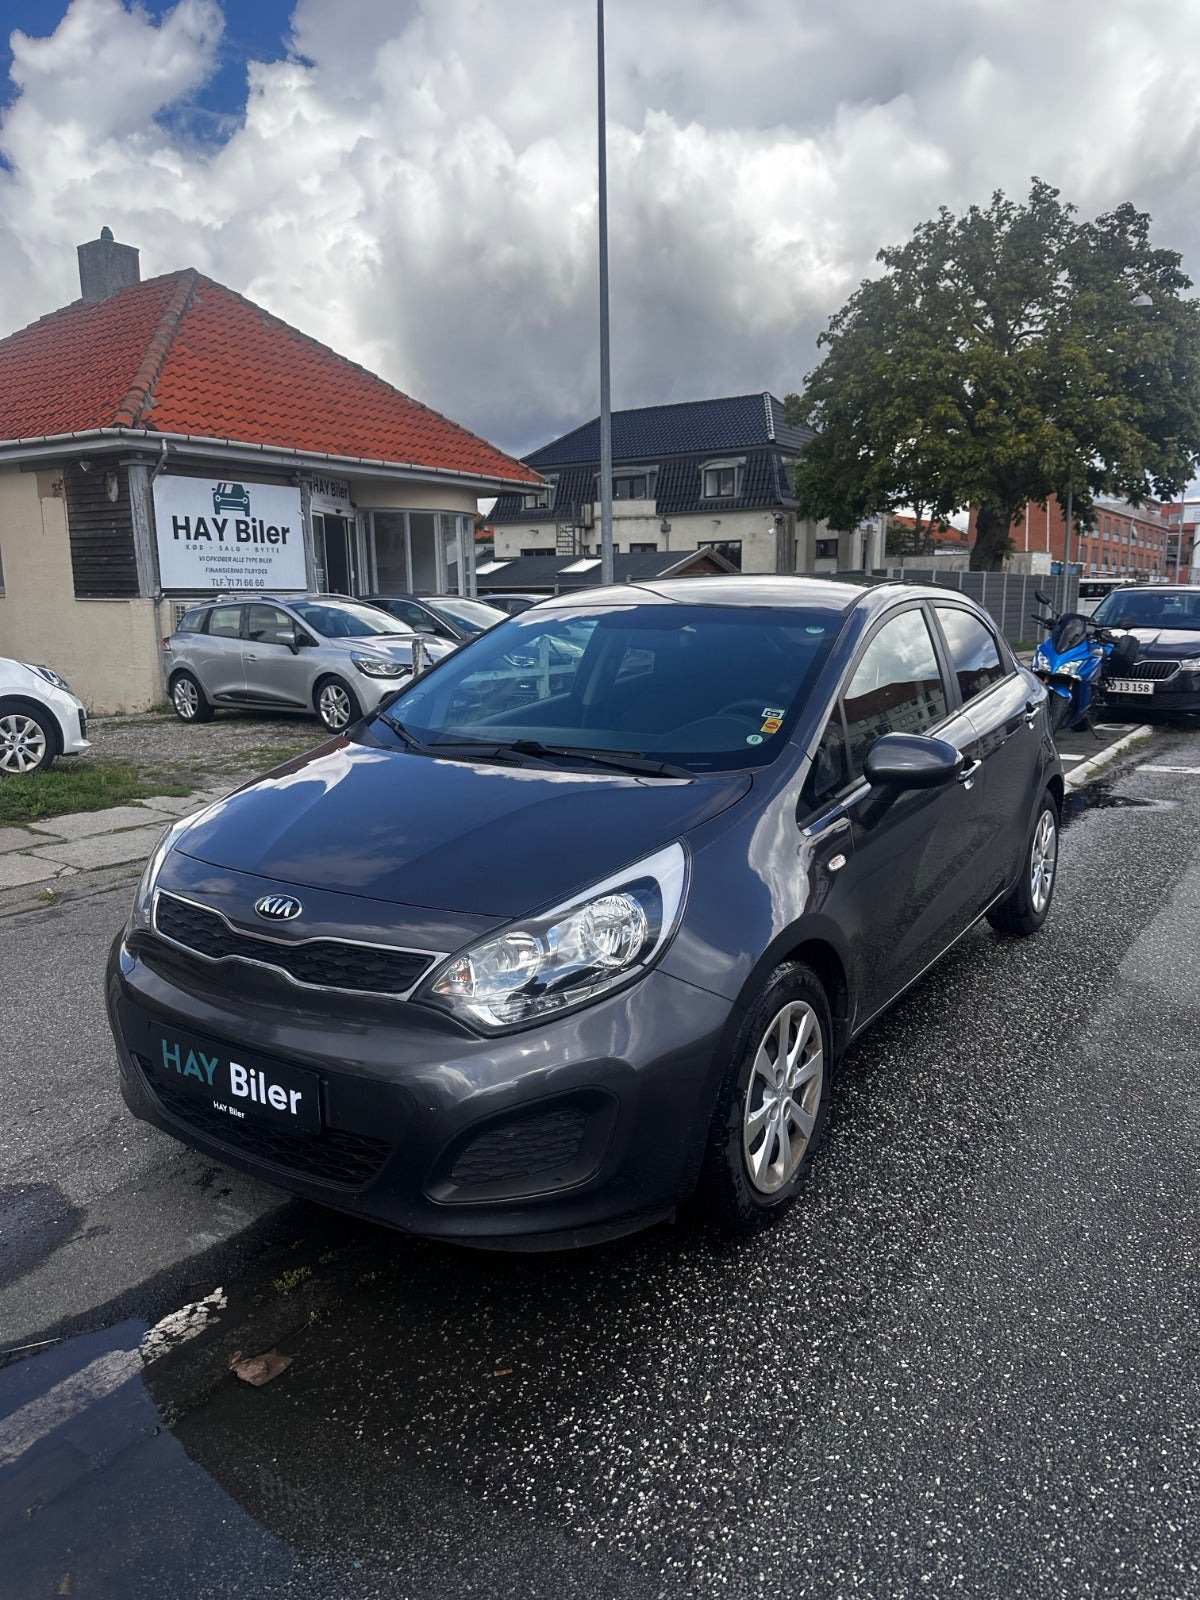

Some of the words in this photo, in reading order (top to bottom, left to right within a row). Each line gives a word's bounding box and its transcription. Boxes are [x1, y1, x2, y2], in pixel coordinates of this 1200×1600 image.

[313, 479, 330, 495] HAY
[330, 481, 348, 500] Biler
[172, 515, 229, 542] HAY
[235, 517, 290, 545] Biler
[254, 546, 280, 554] BYTTE
[205, 555, 232, 563] OPKØBER
[243, 567, 268, 575] TILBYDES
[226, 578, 234, 587] 71
[235, 578, 243, 587] 71
[244, 579, 253, 587] 66
[254, 579, 265, 587] 66
[1119, 683, 1130, 691] 13
[1132, 683, 1150, 693] 158
[260, 897, 293, 917] KIA
[162, 1039, 219, 1086] HAY
[229, 1061, 302, 1115] Biler
[213, 1100, 228, 1112] HAY
[228, 1106, 245, 1119] Biler
